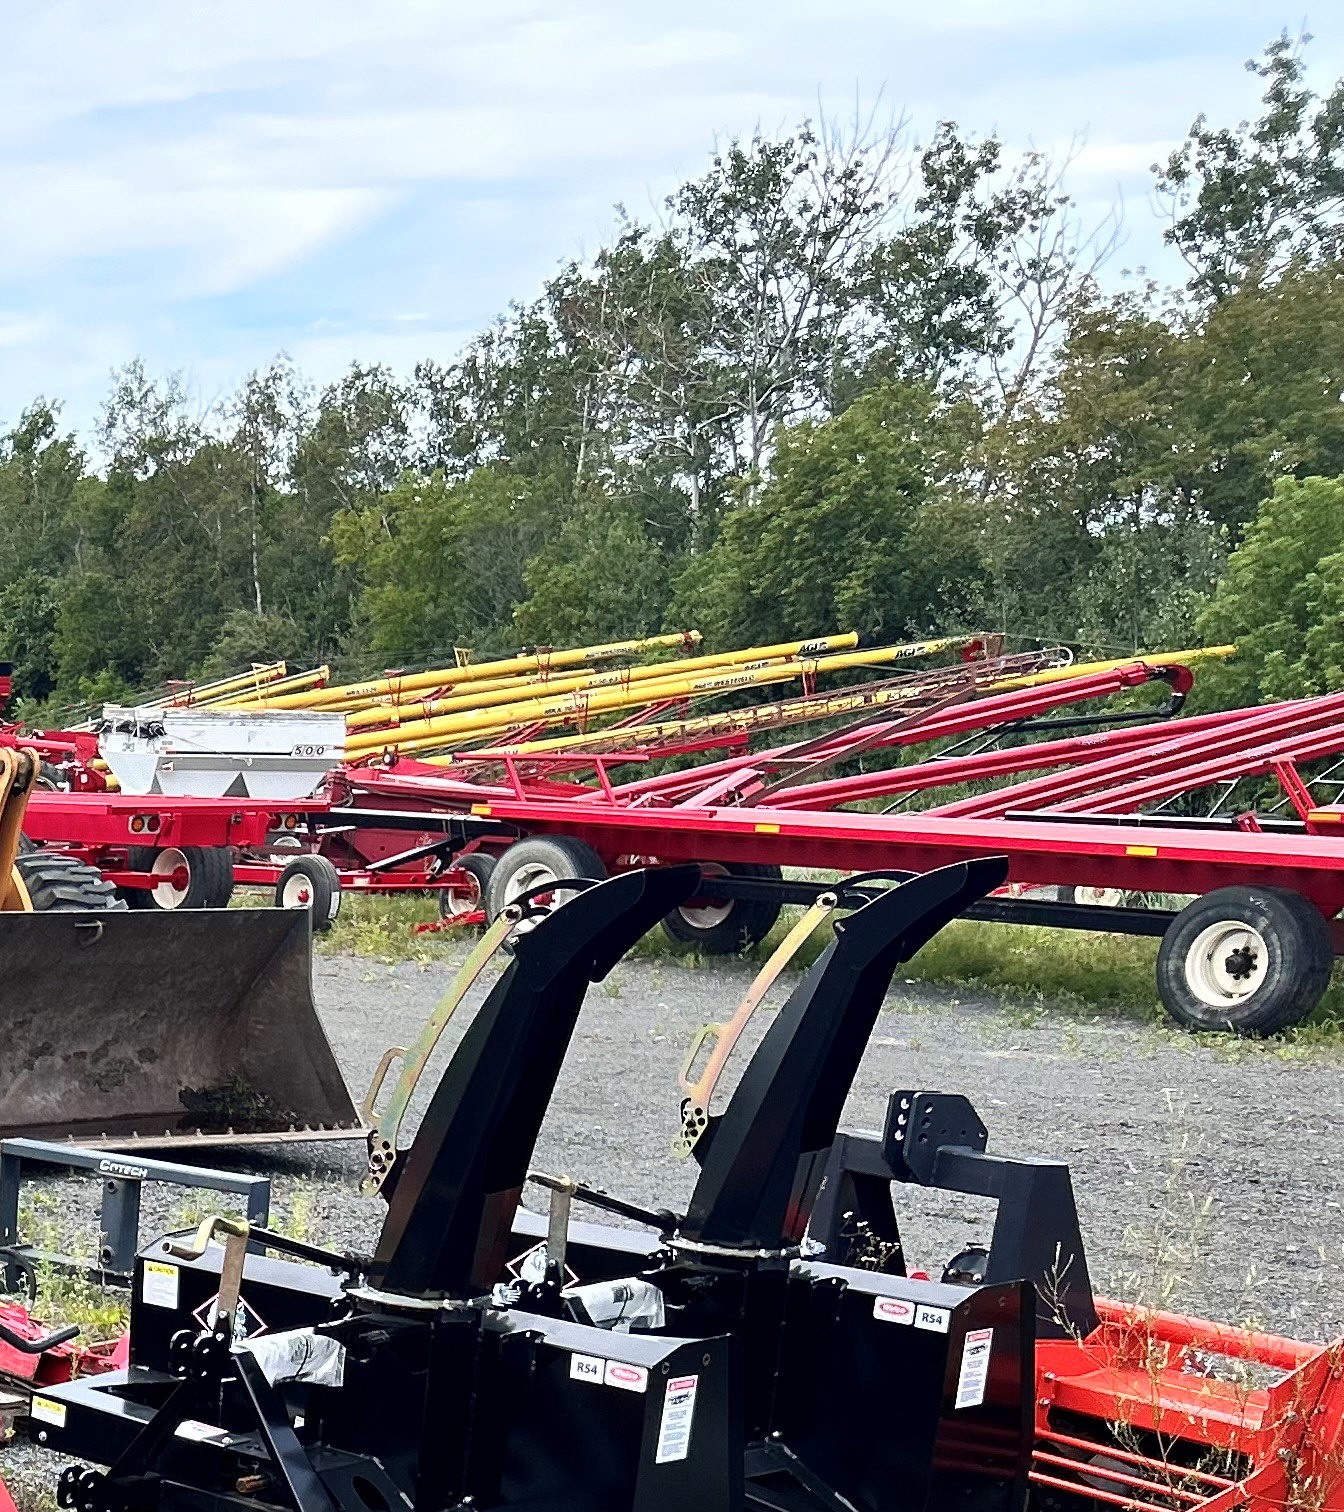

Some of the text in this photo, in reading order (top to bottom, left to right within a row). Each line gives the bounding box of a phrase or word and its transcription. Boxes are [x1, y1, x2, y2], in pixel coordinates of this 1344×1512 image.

[294, 745, 325, 756] 500
[921, 1312, 943, 1326] R54
[576, 1361, 598, 1376] R54
